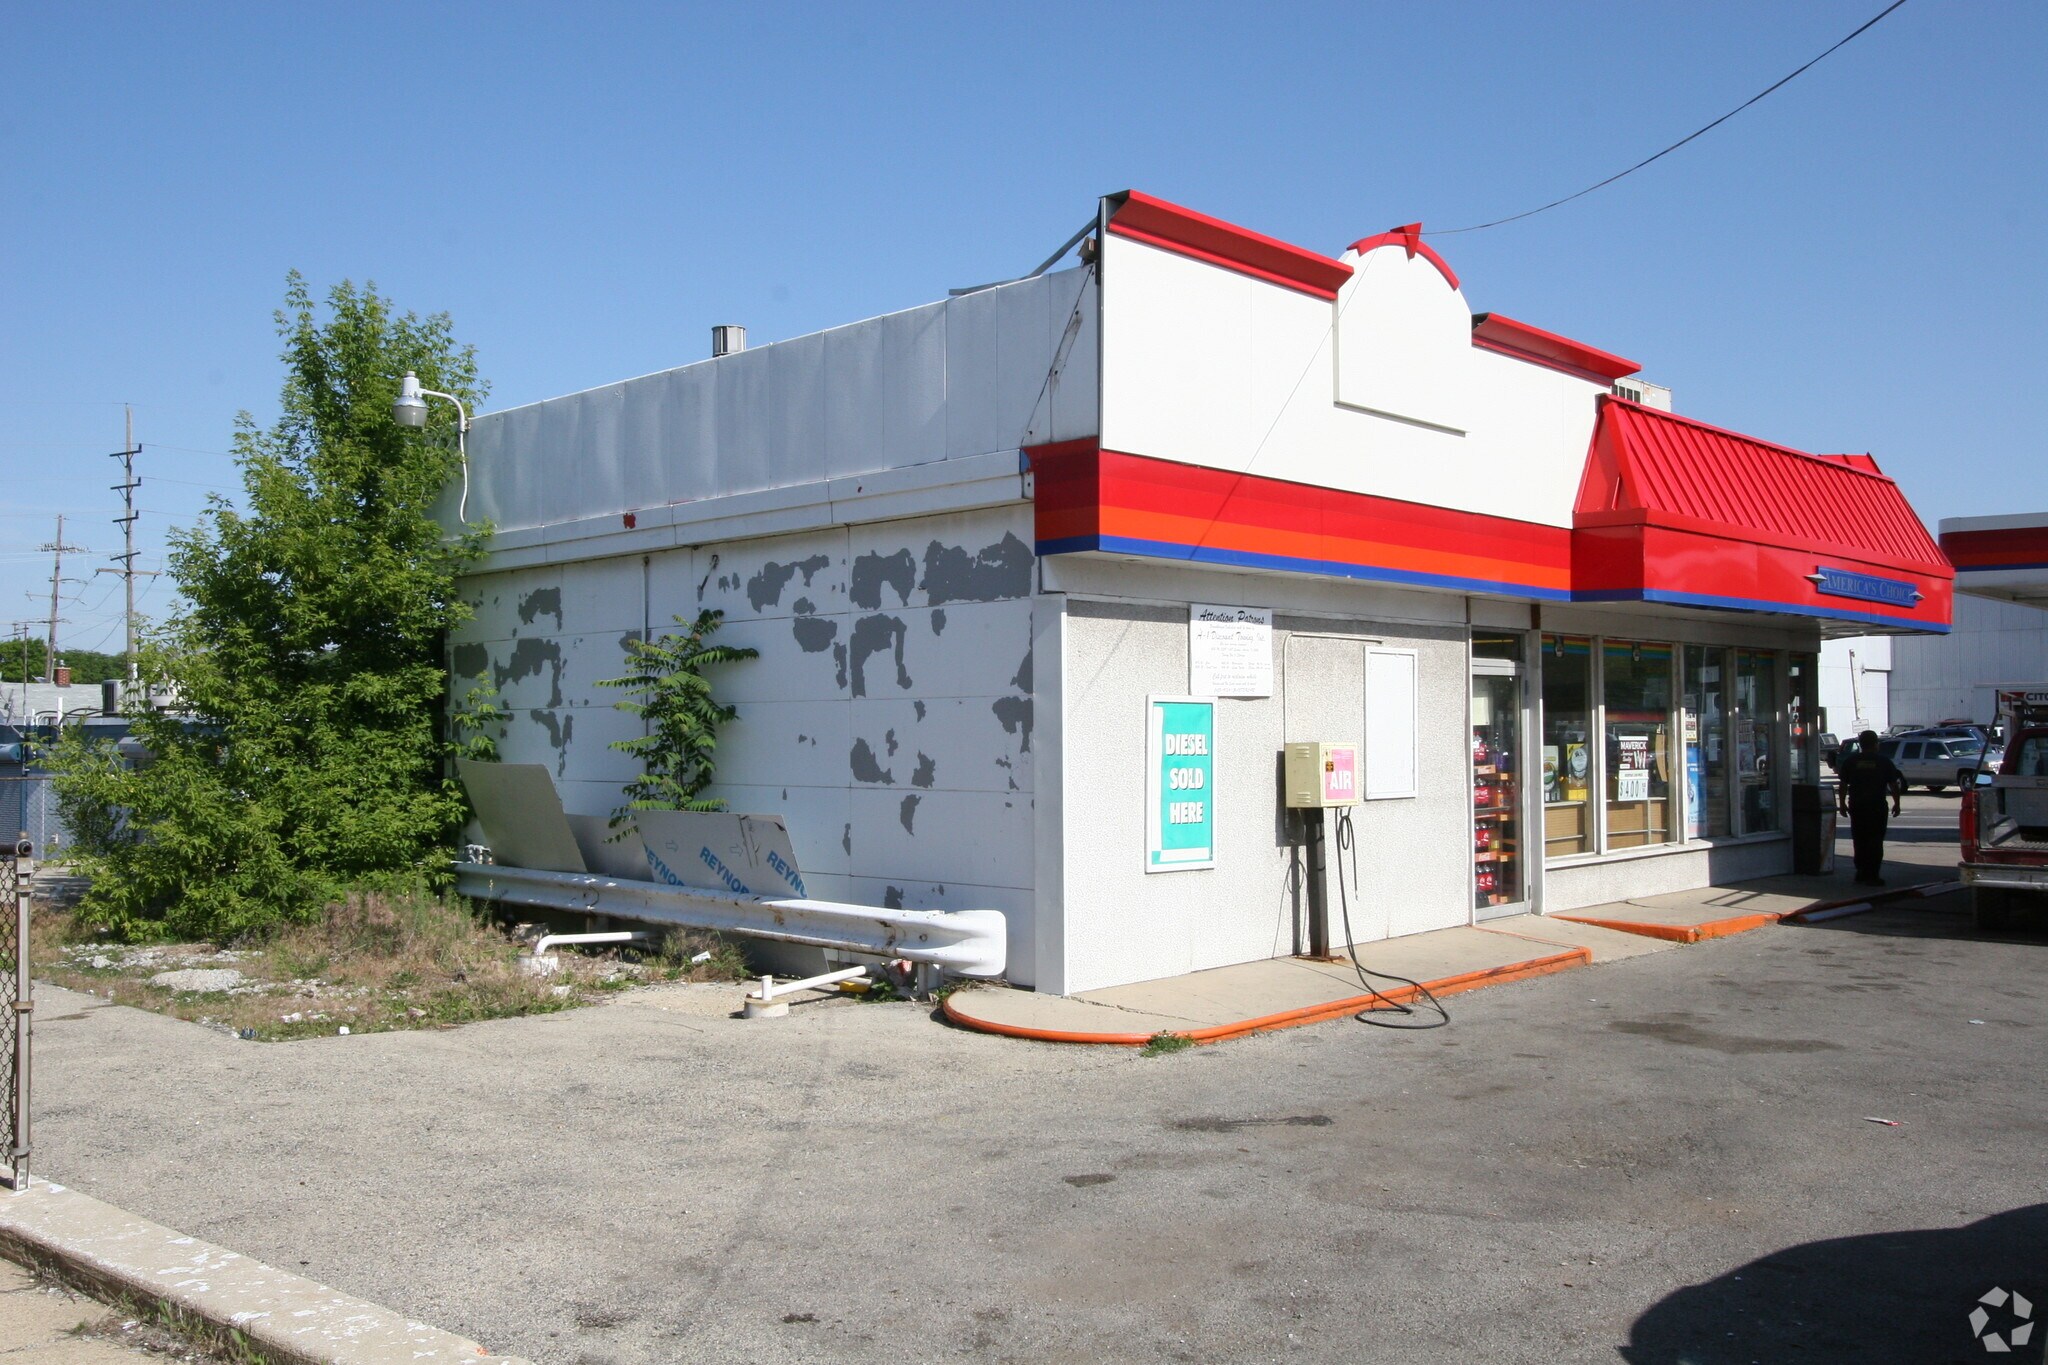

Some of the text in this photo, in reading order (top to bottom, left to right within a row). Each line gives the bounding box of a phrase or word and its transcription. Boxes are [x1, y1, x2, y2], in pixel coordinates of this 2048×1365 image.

[1198, 608, 1265, 624] Attention Patrons
[1166, 734, 1208, 756] DIESEL
[1620, 741, 1647, 750] MAVERICK
[1170, 768, 1204, 790] SOLD
[1329, 770, 1352, 790] AIR
[1169, 802, 1204, 824] HERE
